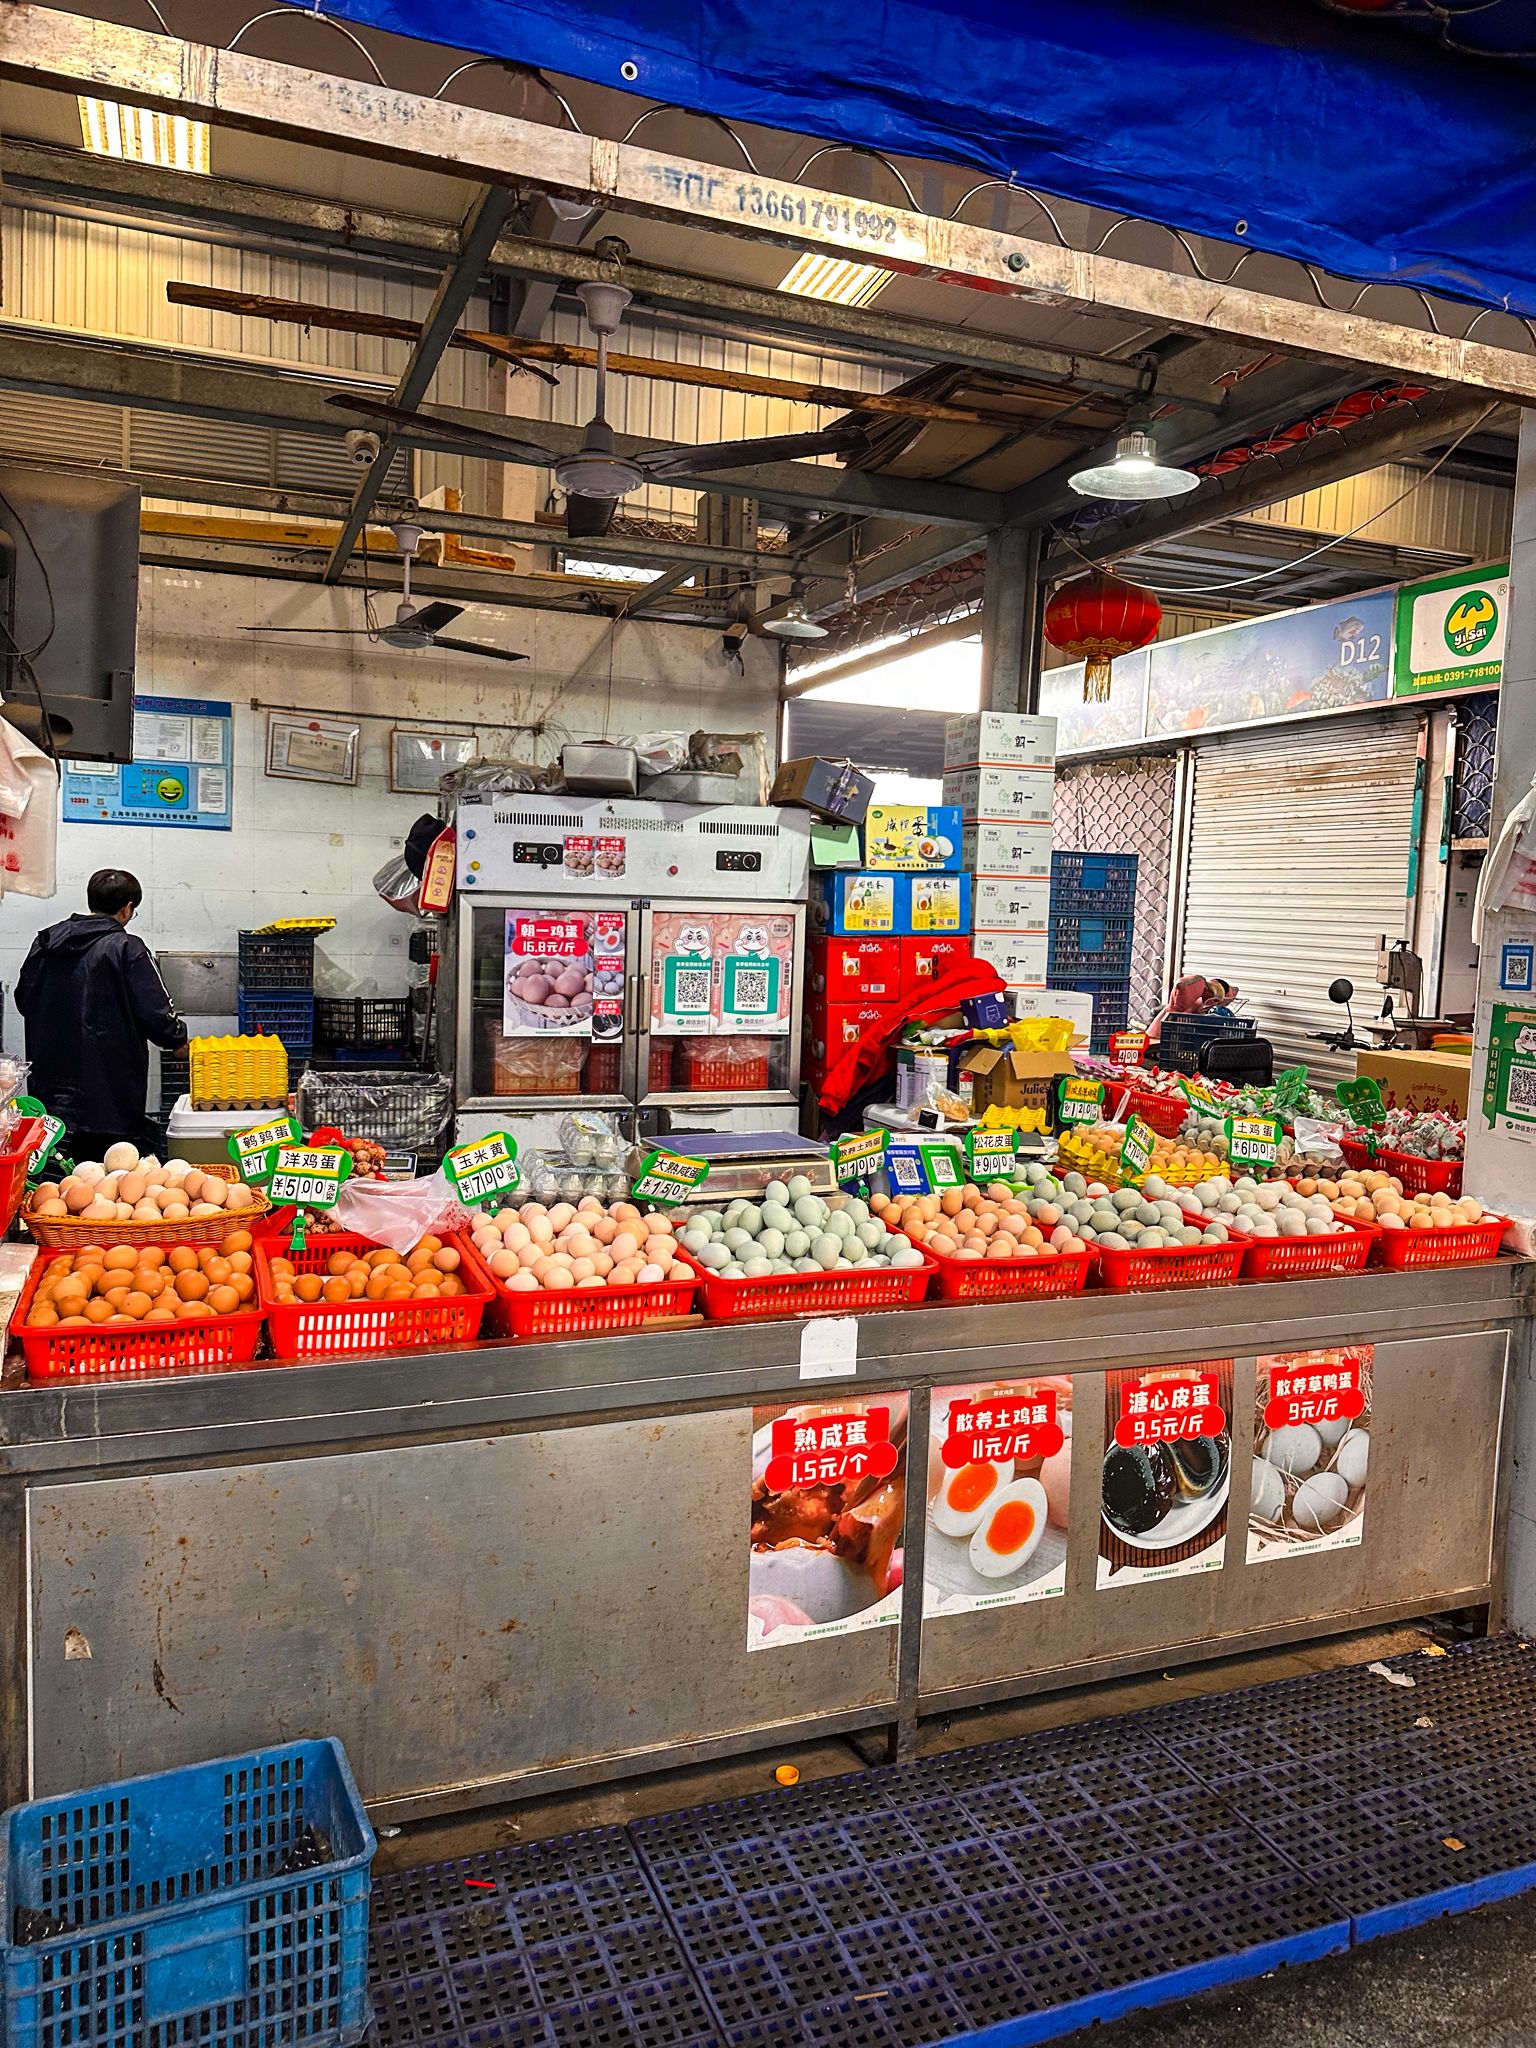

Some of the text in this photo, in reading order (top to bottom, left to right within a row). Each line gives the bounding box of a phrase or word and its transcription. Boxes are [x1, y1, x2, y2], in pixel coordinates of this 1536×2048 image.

[1340, 635, 1381, 666] D12
[520, 923, 578, 938] 朝一鸡蛋
[522, 941, 576, 953] 16.8元/斤
[1020, 1083, 1052, 1095] Julie's
[243, 1124, 289, 1149] 鹌鹑蛋
[1237, 1122, 1274, 1137] 土鸡蛋
[974, 1136, 1012, 1149] 松花皮蛋
[284, 1152, 336, 1169] 洋鸡蛋
[458, 1142, 505, 1170] 玉米黄
[652, 1158, 704, 1180] 大熟咸蛋
[1276, 1372, 1352, 1396] 散养草鸭蛋
[1128, 1384, 1210, 1414] 溏心皮蛋
[1289, 1398, 1338, 1420] 9元/斤
[956, 1405, 1048, 1432] 散养土鸡蛋
[1134, 1414, 1203, 1440] 9.5元/斤
[794, 1420, 868, 1452] 熟咸蛋
[973, 1433, 1030, 1459] 11元/斤
[792, 1452, 868, 1483] 1.5元/个
